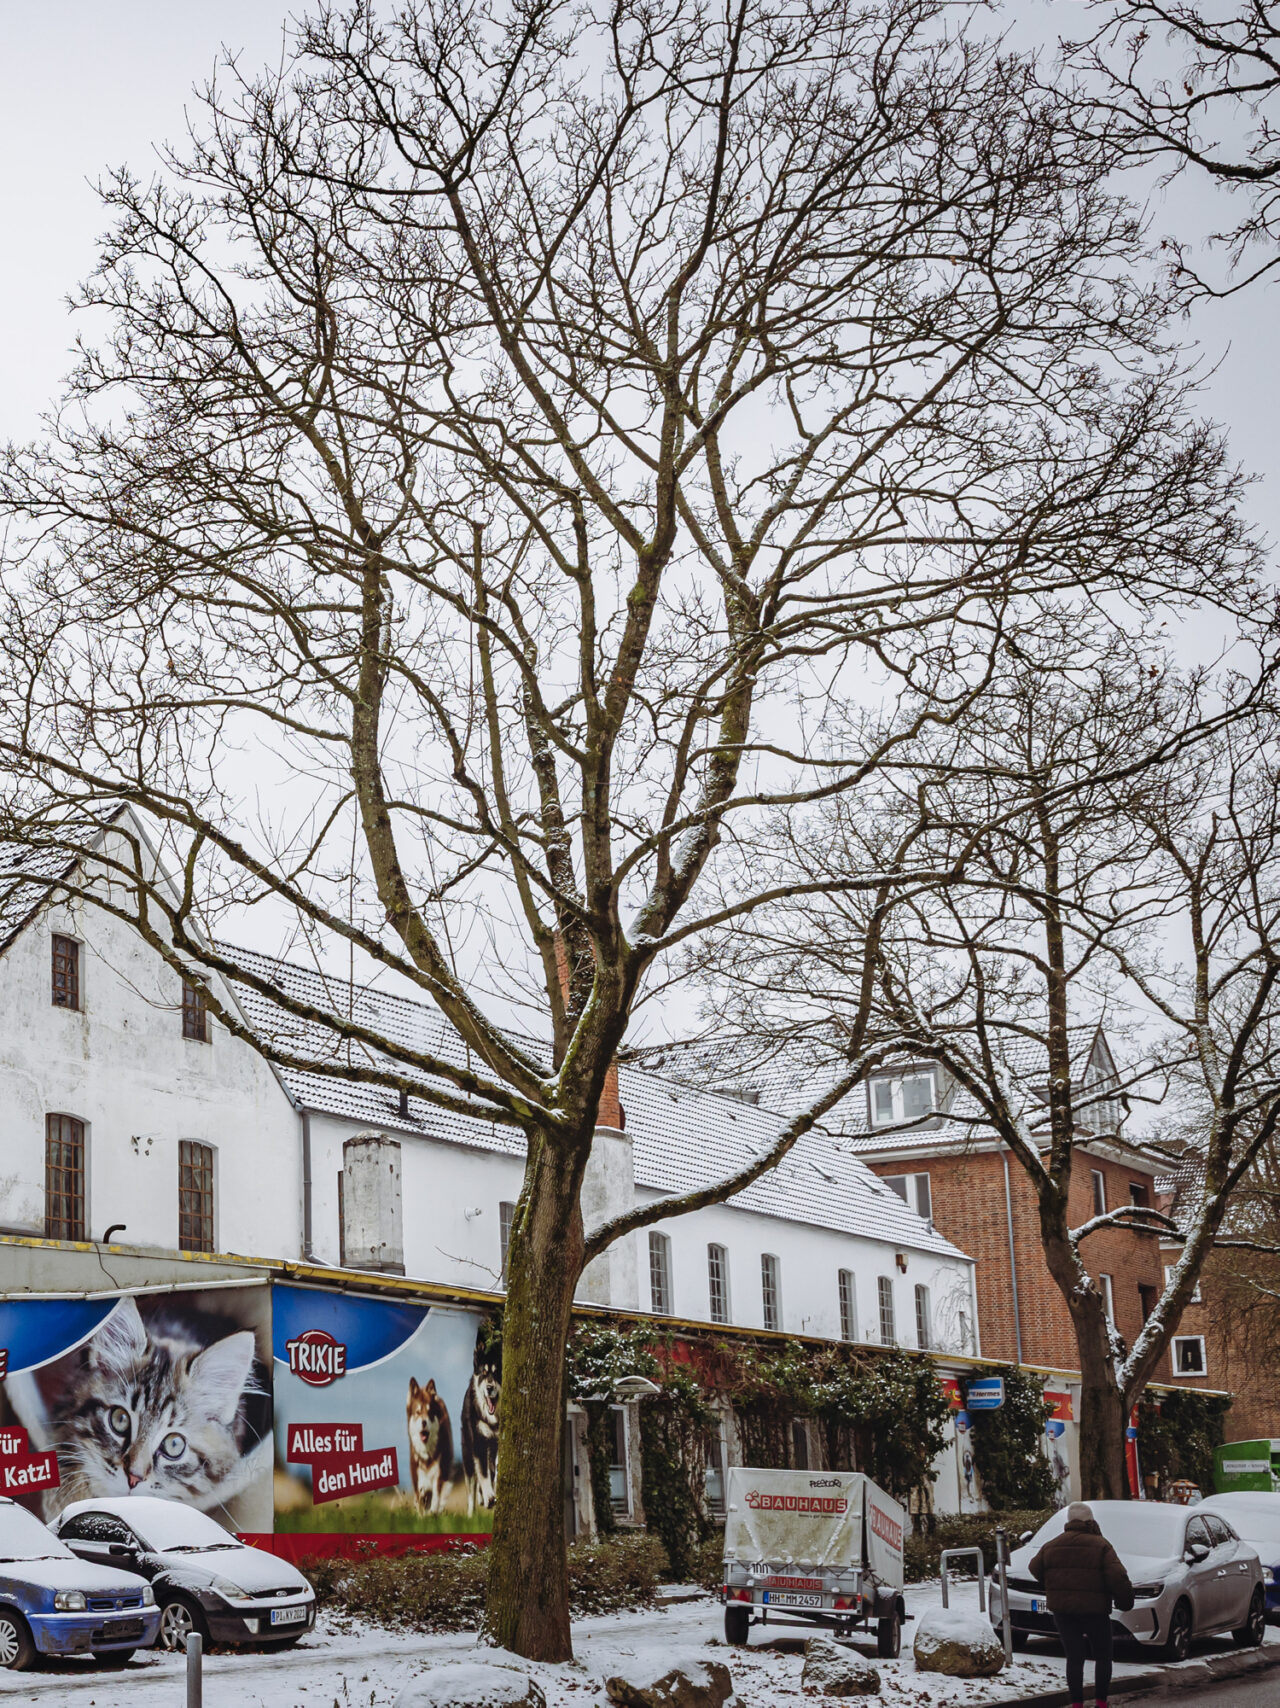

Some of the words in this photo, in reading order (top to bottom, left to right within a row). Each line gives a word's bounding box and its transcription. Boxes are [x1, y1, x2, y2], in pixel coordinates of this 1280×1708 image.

[289, 1341, 346, 1376] TRIXIE
[292, 1431, 331, 1453] Alles
[334, 1428, 358, 1451] für
[4, 1458, 51, 1488] Katz!
[318, 1468, 347, 1495] den
[348, 1456, 393, 1490] Hund!
[761, 1496, 847, 1512] BAUHAUS
[763, 1576, 822, 1589] AUHAUS
[769, 1594, 780, 1604] HH
[786, 1594, 797, 1605] MM
[798, 1596, 820, 1606] 2457
